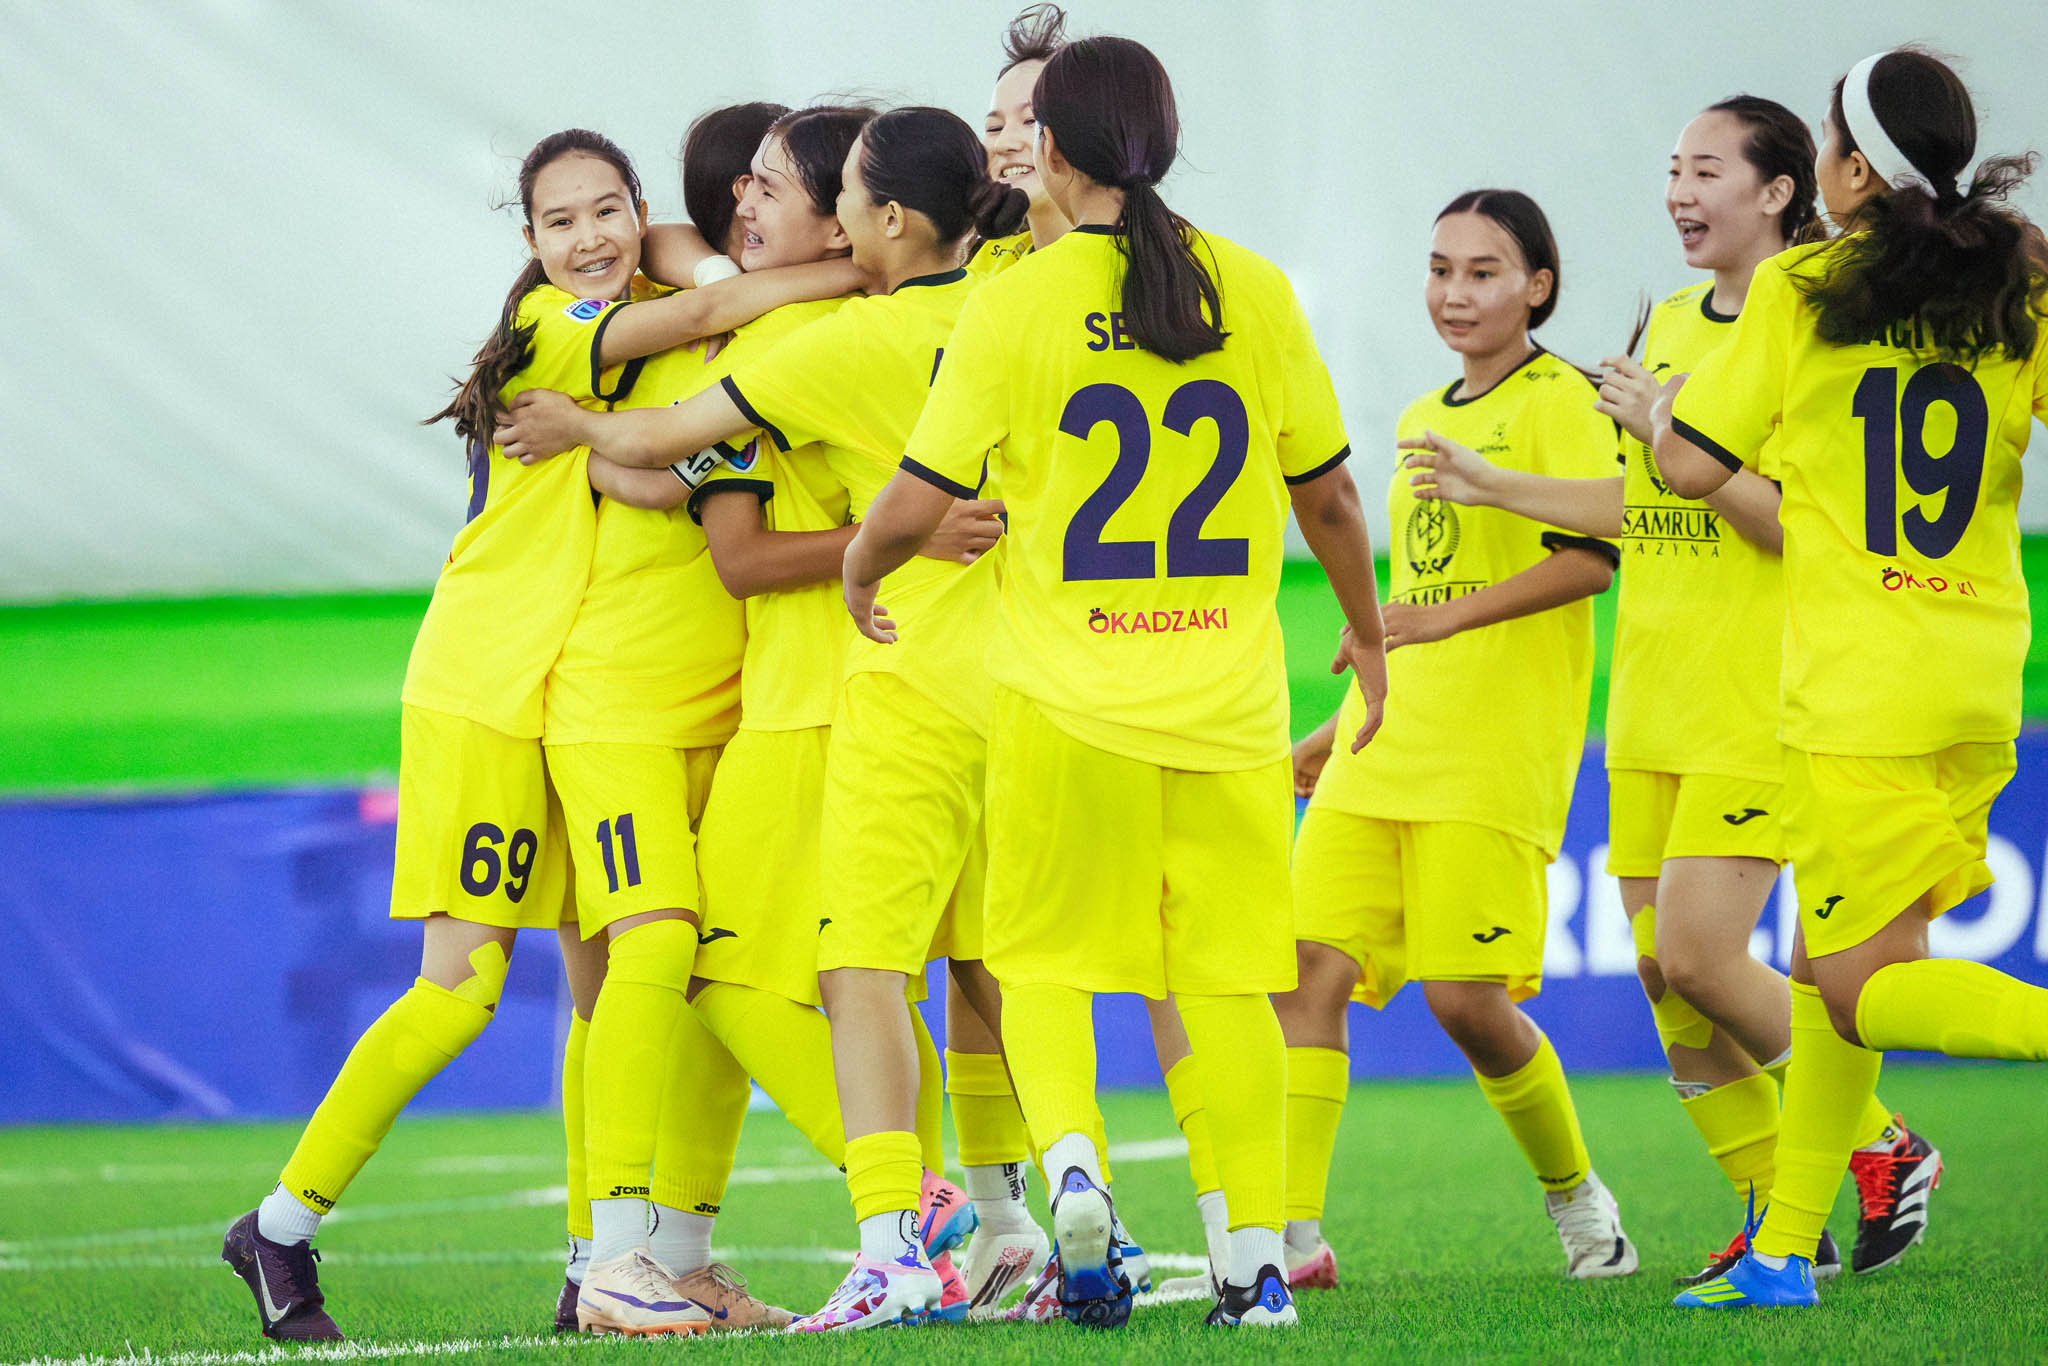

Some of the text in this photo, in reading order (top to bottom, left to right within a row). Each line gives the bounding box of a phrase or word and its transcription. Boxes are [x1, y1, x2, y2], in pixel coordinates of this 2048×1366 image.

[1058, 379, 1250, 582] 22
[1851, 361, 1989, 560] 19
[1621, 541, 1720, 558] AZYNA
[1622, 509, 1721, 538] SAMRUK
[460, 822, 538, 904] 69
[596, 812, 642, 895] 11
